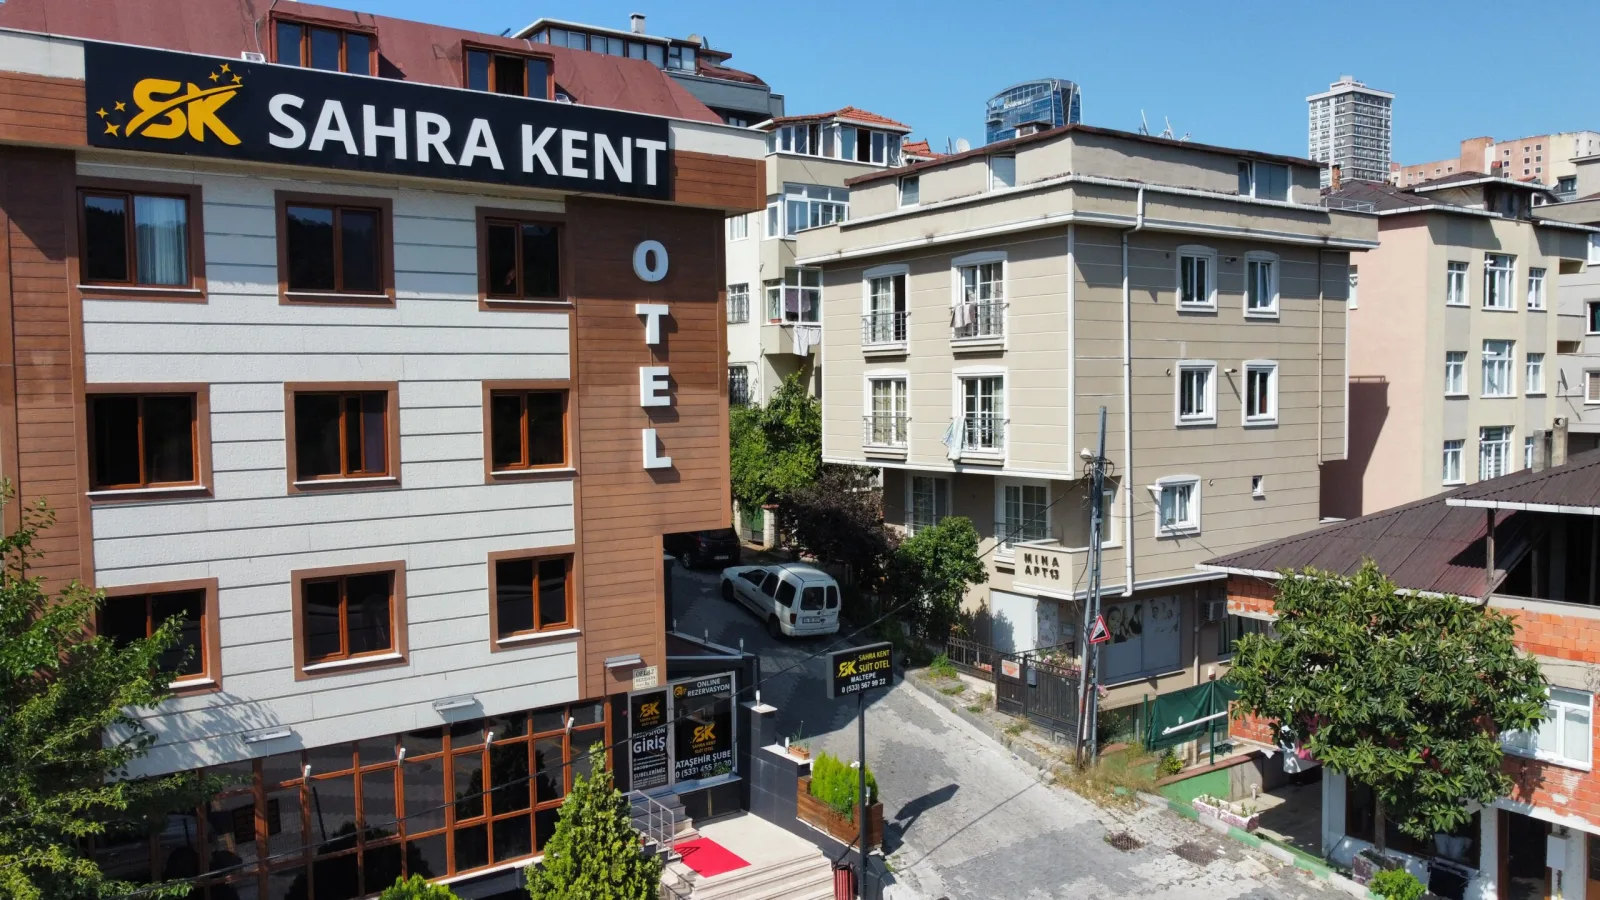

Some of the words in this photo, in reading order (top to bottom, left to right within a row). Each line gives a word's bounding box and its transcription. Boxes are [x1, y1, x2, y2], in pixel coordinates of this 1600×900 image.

[267, 93, 505, 171] SAHRA
[520, 123, 667, 187] KENT
[633, 239, 673, 469] OTEL
[1024, 552, 1060, 568] MINA
[858, 652, 876, 661] SAHRA
[876, 649, 890, 658] KENT
[874, 660, 890, 670] OTEL
[697, 678, 721, 688] ONLINE
[850, 672, 876, 683] MALTEPE
[688, 684, 730, 696] REZERVASYON
[846, 684, 860, 693] (533)
[861, 681, 871, 689] 567
[633, 735, 665, 753] GİRİŞ
[675, 754, 711, 769] ATAŞEHİR
[712, 749, 731, 762] ŞUBE
[675, 771, 680, 779] 0
